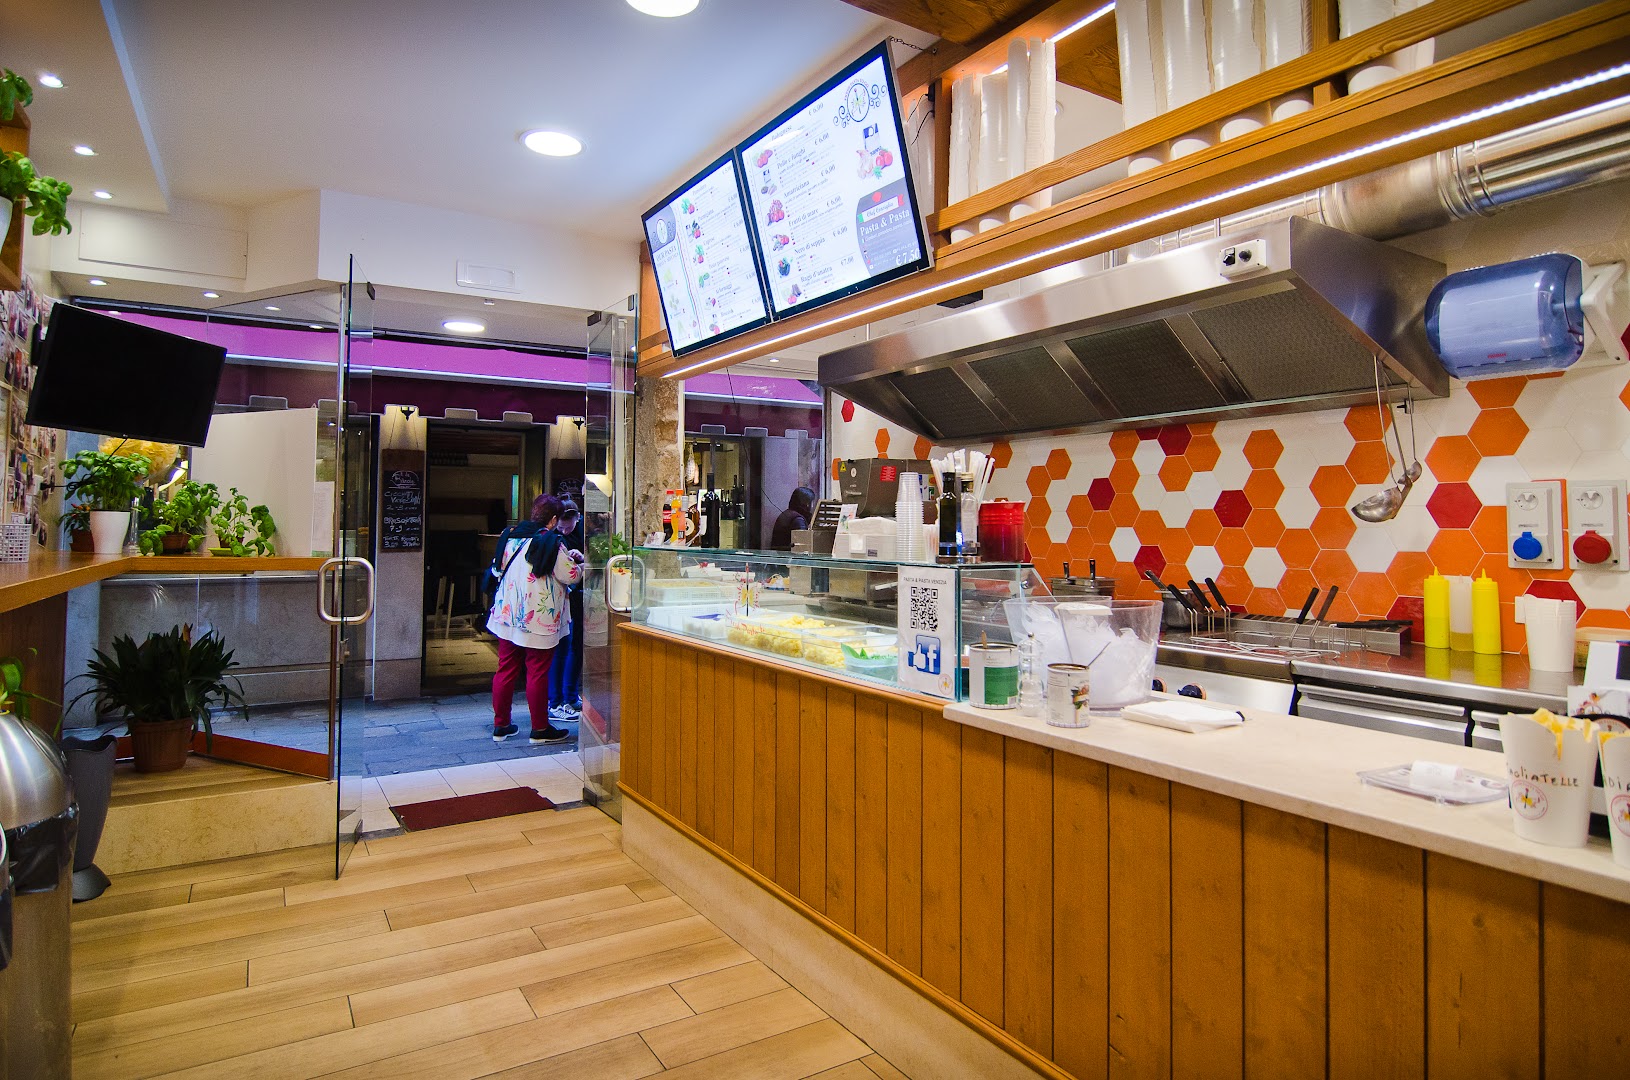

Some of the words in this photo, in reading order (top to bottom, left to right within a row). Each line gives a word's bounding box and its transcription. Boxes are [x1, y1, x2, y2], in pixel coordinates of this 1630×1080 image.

[859, 220, 879, 236] Pasta
[879, 215, 887, 227] &
[888, 206, 909, 224] Pasta
